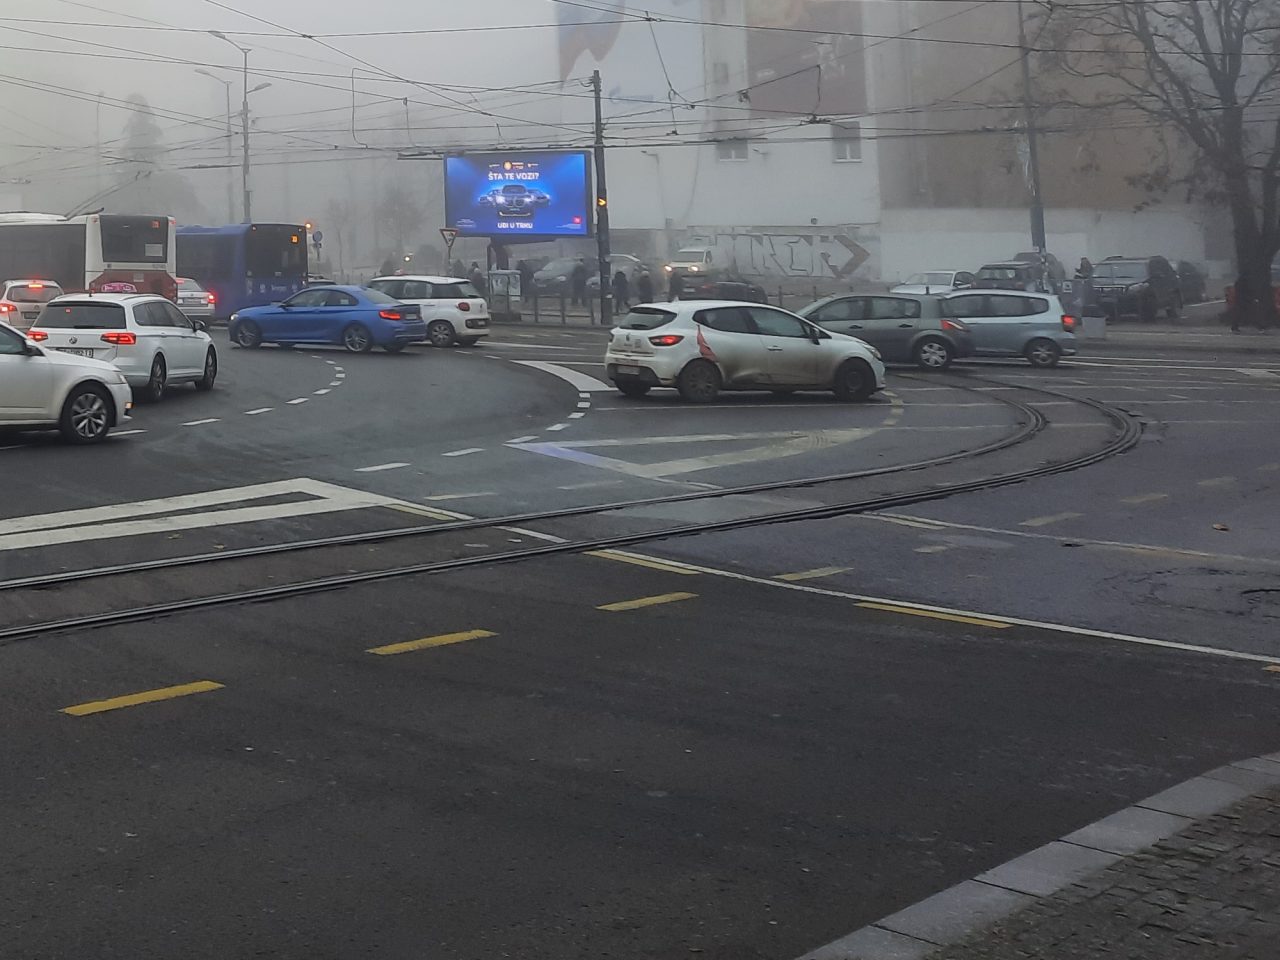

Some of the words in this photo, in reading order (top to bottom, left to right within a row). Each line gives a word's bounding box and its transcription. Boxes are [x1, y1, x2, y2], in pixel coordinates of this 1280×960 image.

[488, 171, 503, 181] ŠTA
[504, 172, 515, 180] TE
[516, 172, 540, 180] VOZI?
